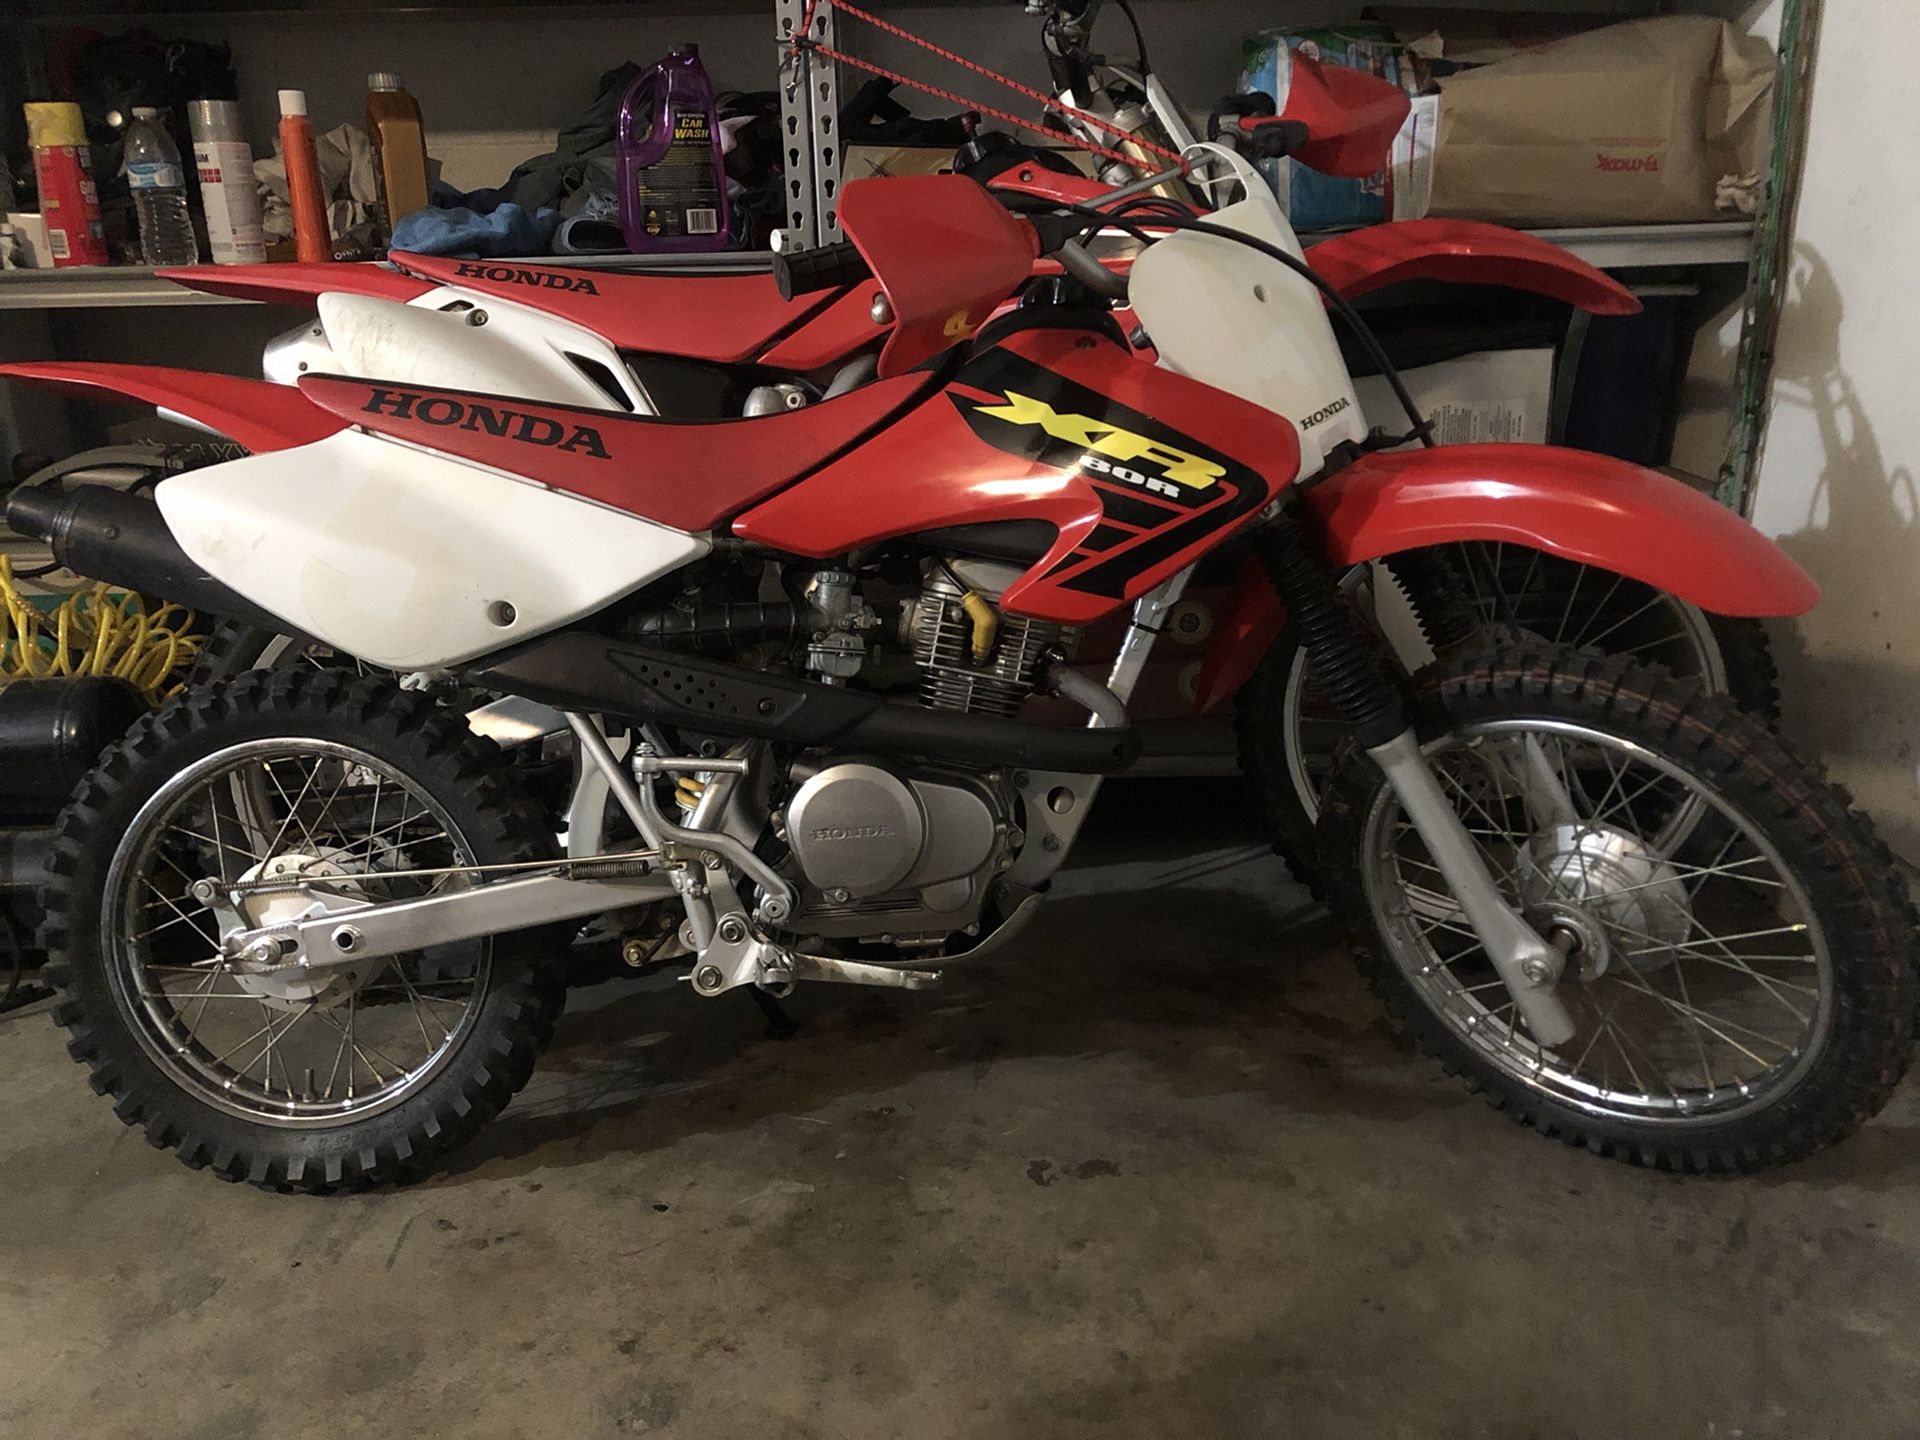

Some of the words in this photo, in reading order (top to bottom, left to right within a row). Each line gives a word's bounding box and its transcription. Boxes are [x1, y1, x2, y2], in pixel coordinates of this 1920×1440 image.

[675, 128, 709, 139] WASH
[681, 118, 703, 128] CAR
[454, 263, 600, 296] HONDA
[361, 388, 612, 459] HONDA
[1300, 397, 1350, 431] HONDA
[972, 389, 1227, 490] XR
[1079, 455, 1180, 499] 80R
[809, 824, 895, 841] HONDA
